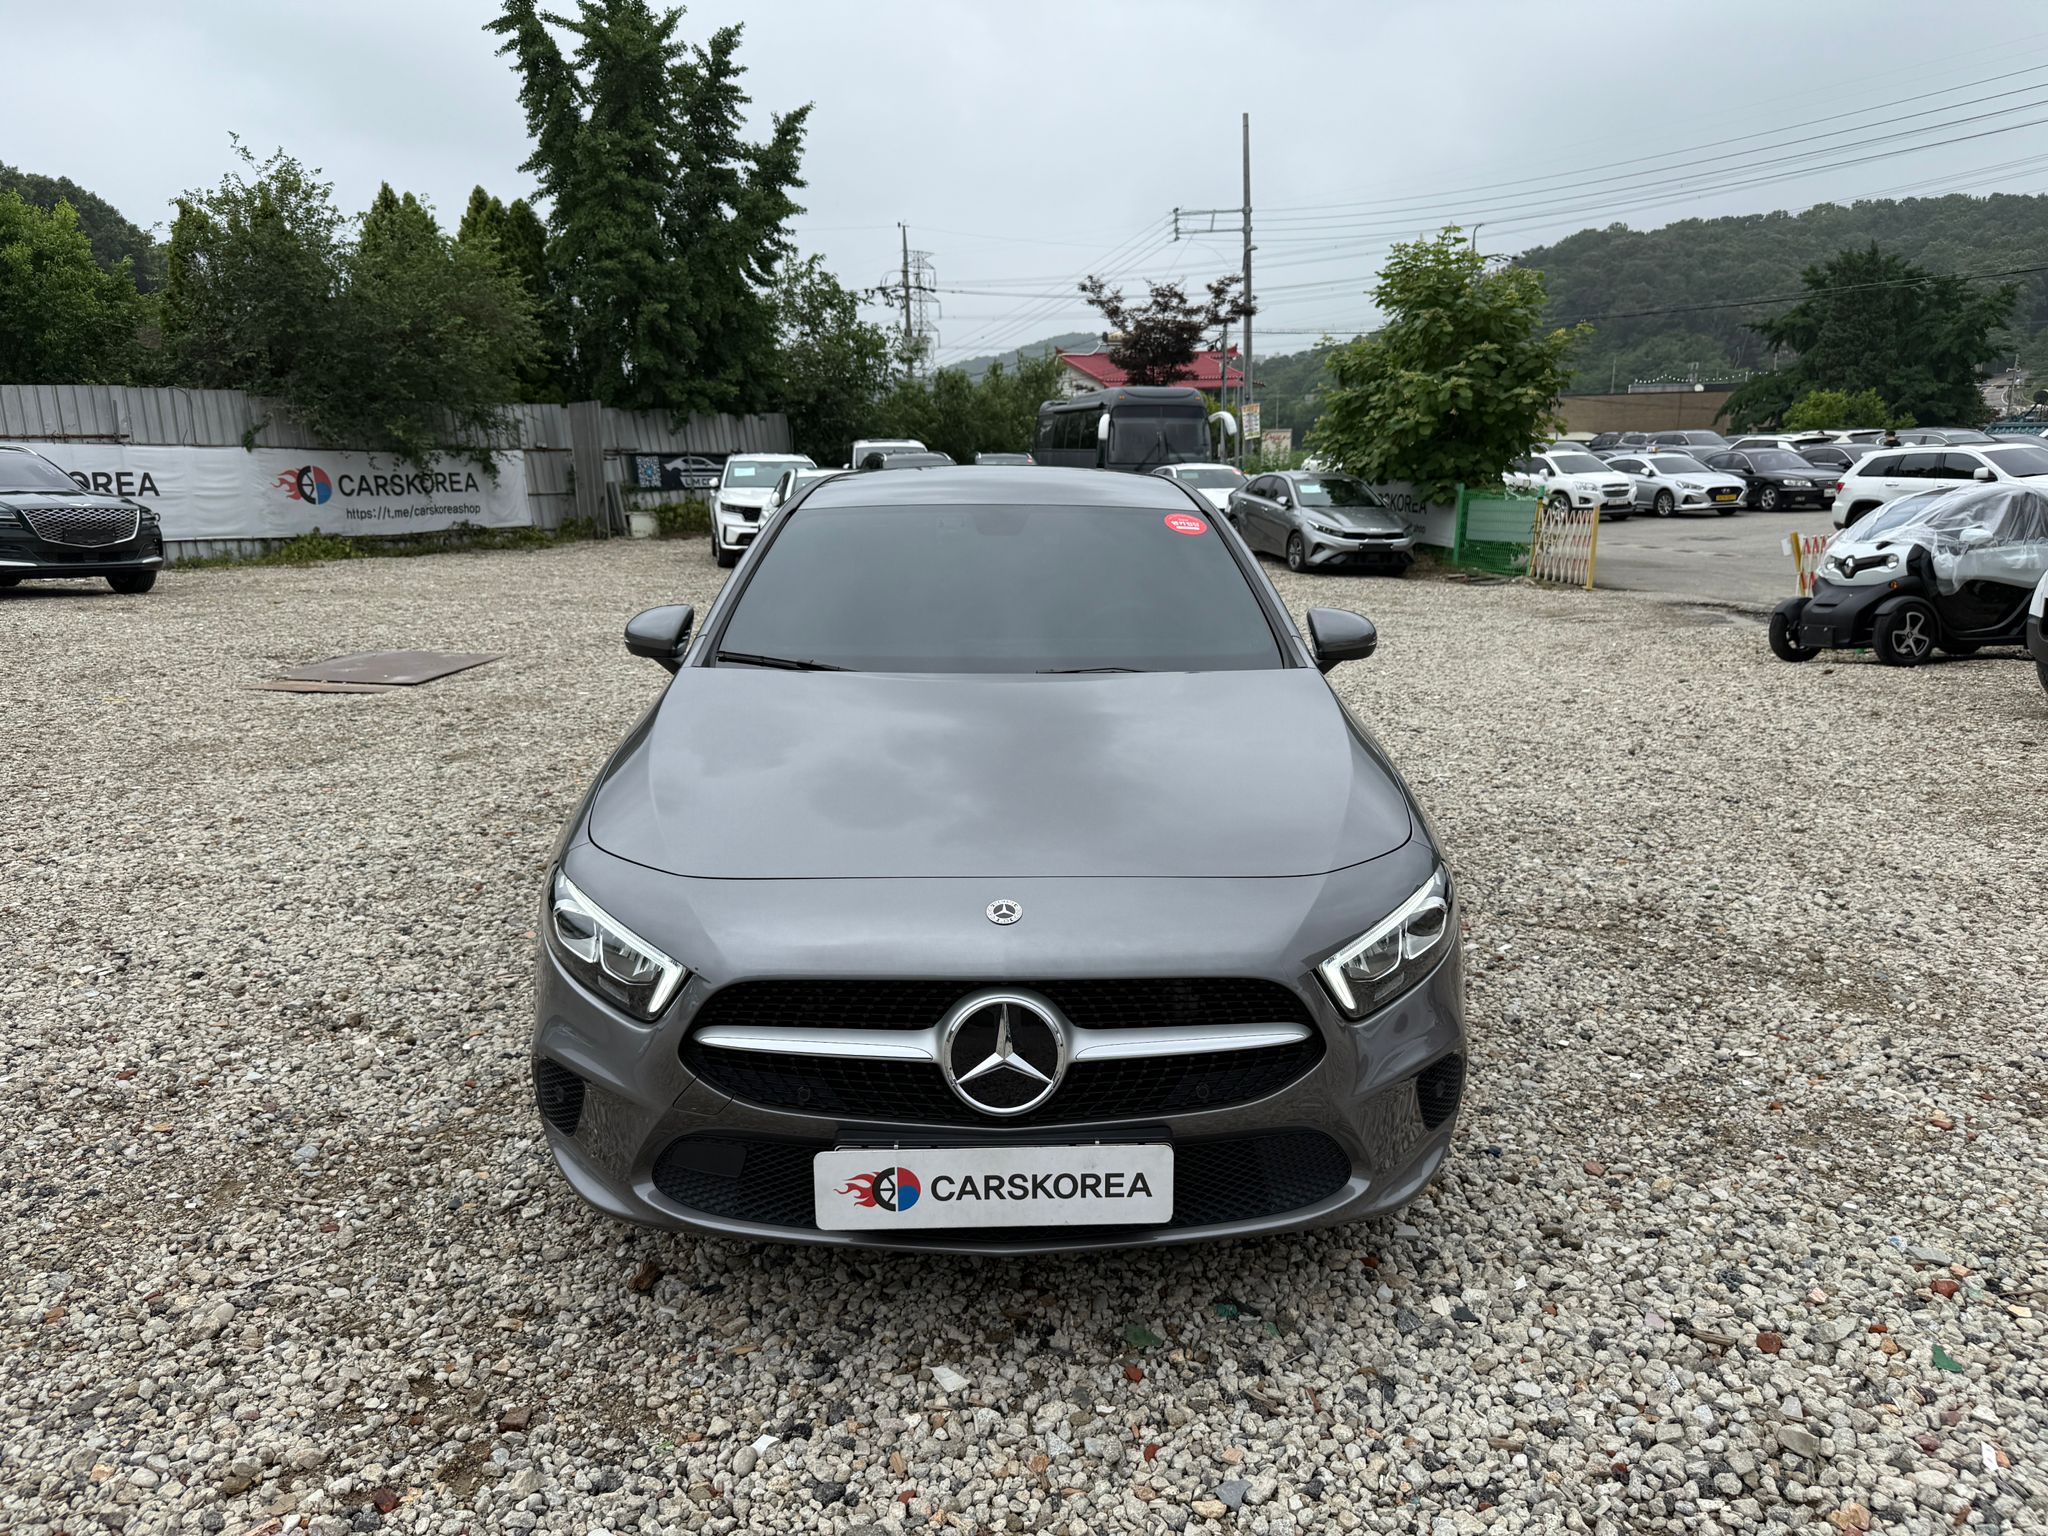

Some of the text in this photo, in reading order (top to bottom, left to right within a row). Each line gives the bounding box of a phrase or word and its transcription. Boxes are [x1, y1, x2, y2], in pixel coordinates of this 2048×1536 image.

[338, 472, 479, 497] CARSKOREA
[346, 503, 481, 520] https://t.me/carskoreashop
[930, 1172, 1153, 1201] CARSKOREA
